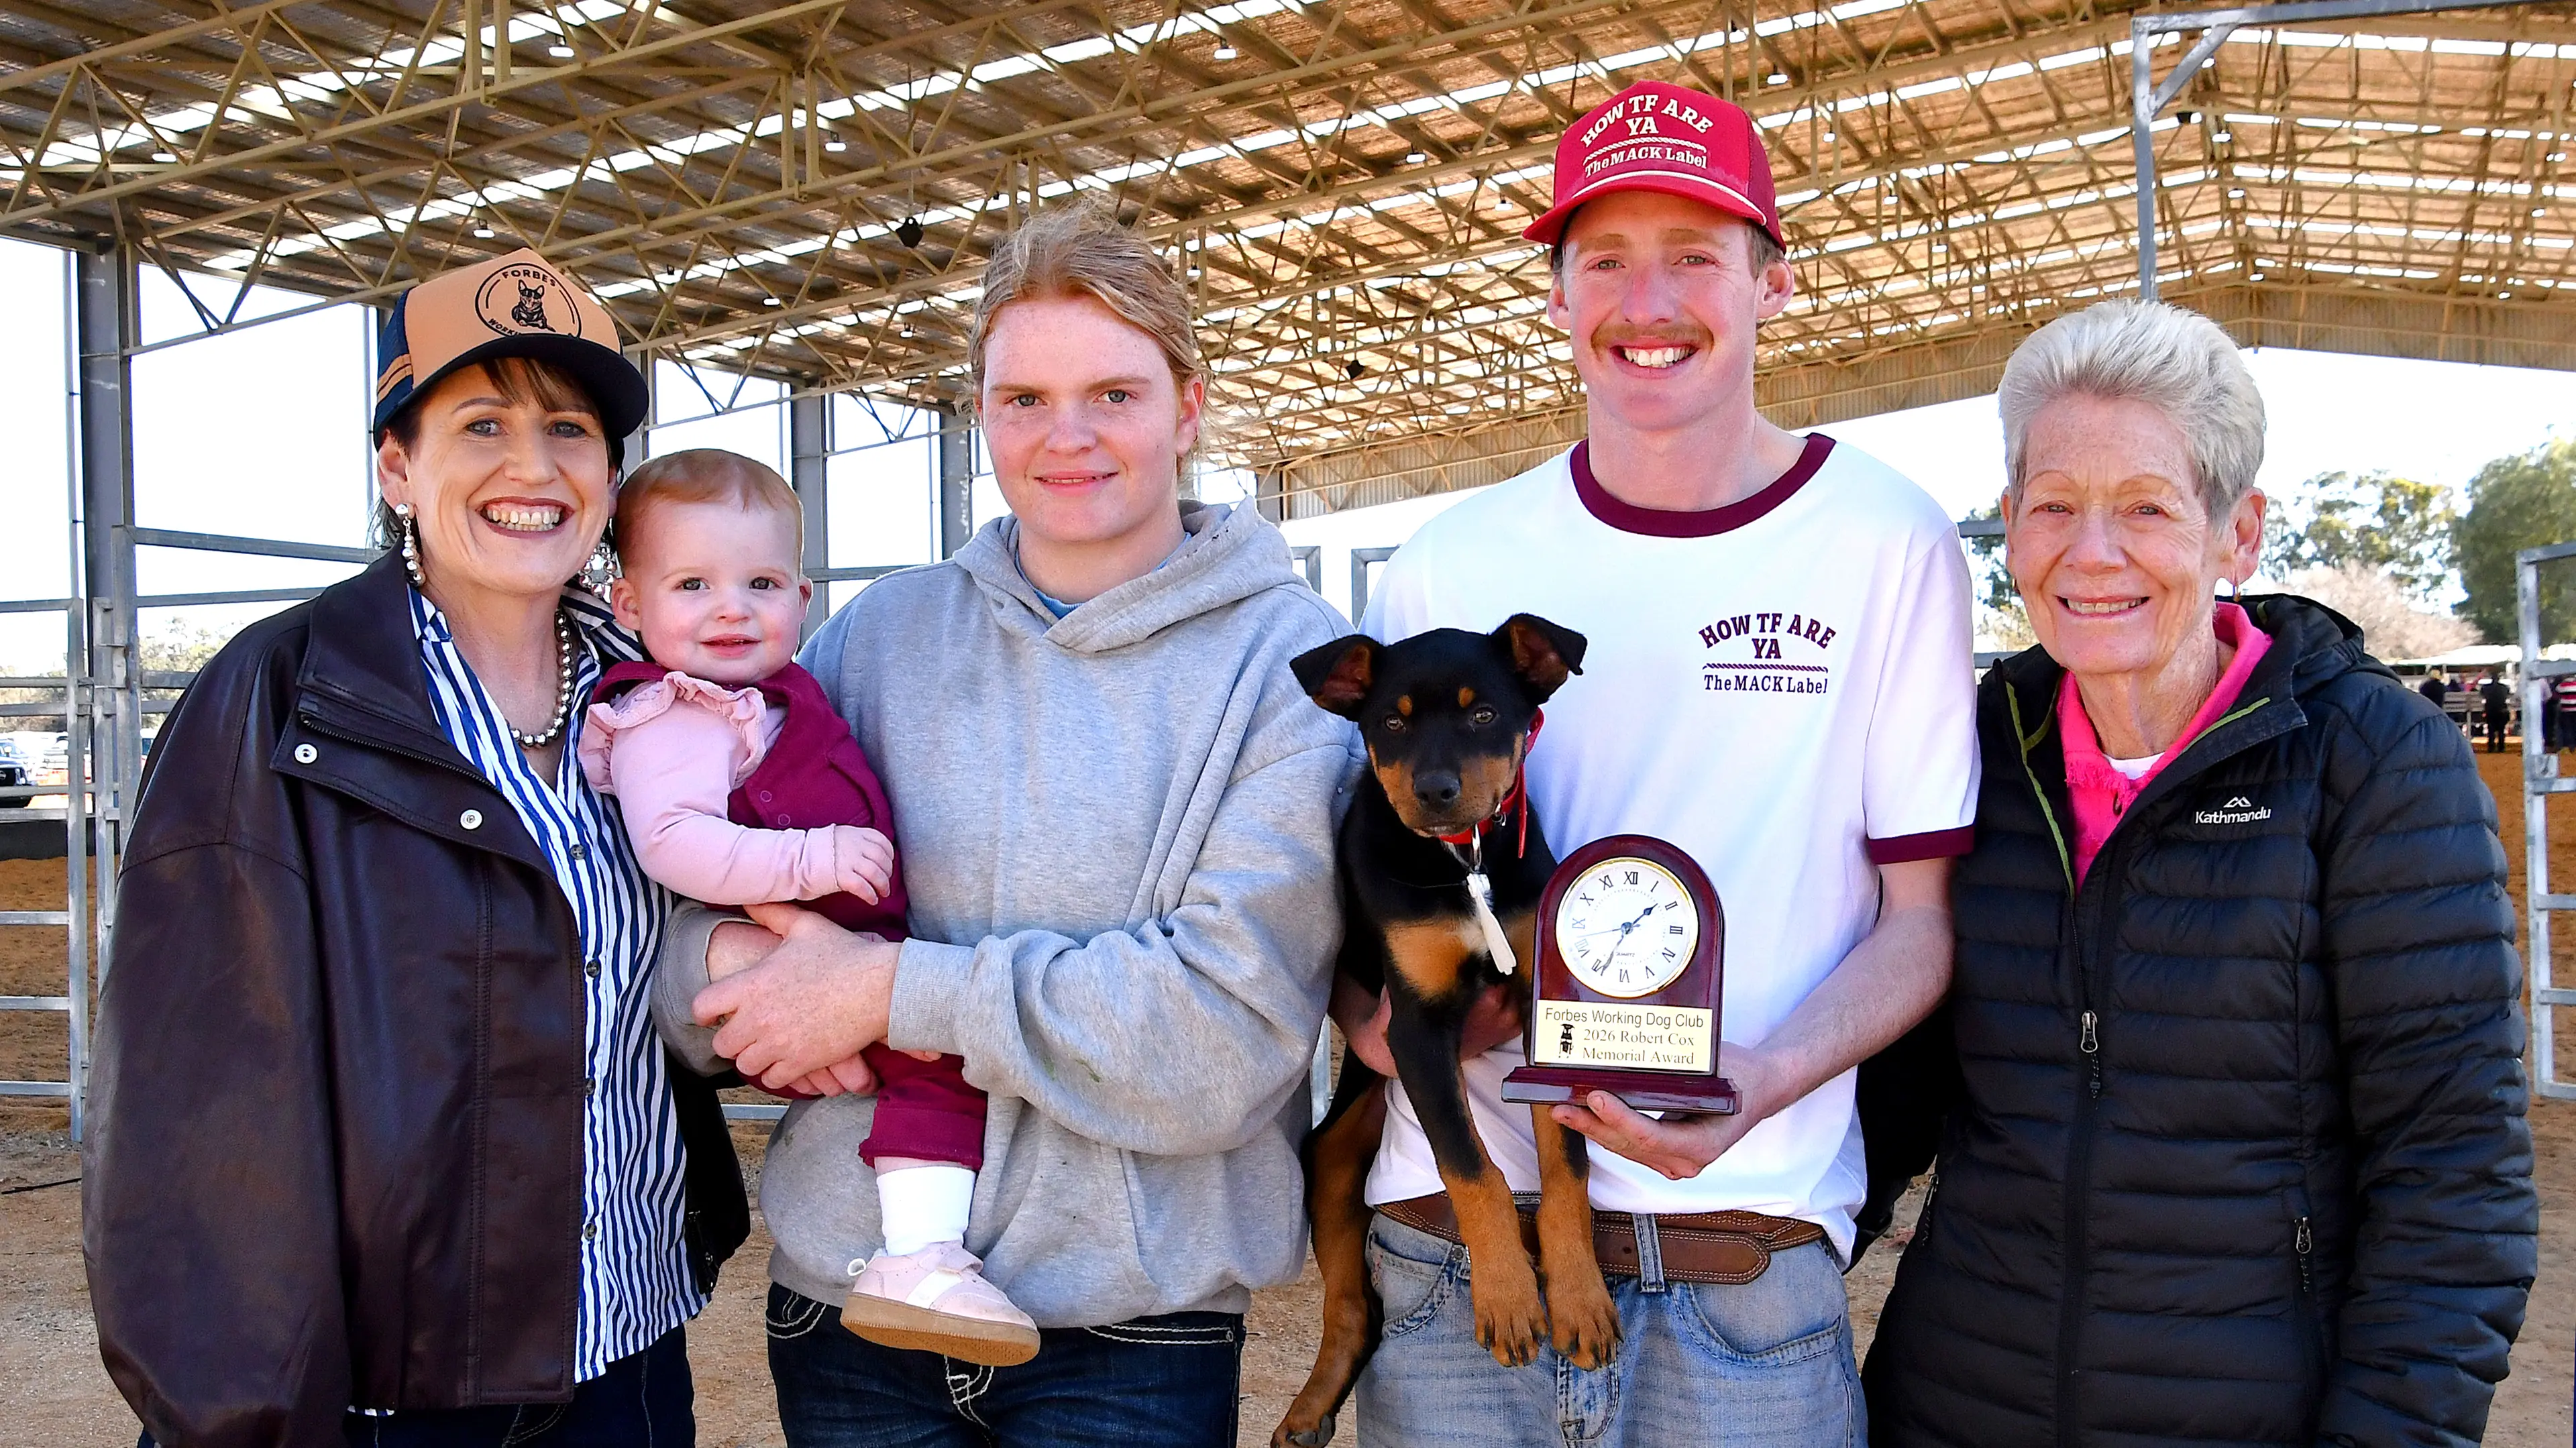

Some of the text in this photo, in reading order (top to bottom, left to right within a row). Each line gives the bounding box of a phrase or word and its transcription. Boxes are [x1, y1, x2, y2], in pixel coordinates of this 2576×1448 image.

[1580, 95, 1713, 148] HOW TF ARE
[1625, 116, 1659, 136] YA
[1665, 148, 1707, 169] Label
[502, 270, 556, 286] FORBES
[488, 319, 522, 335] WORKI
[1699, 613, 1836, 649] HOW TF ARE
[1752, 638, 1782, 659] YA
[1786, 677, 1828, 693] Label
[2195, 806, 2271, 824] Kathmandu
[1599, 875, 1613, 891] XI
[1623, 871, 1638, 885] XII
[1650, 881, 1659, 892] I
[1579, 893, 1595, 906] X
[1664, 901, 1678, 910] II
[1572, 918, 1585, 929] IX
[1669, 925, 1683, 935] III
[1662, 947, 1676, 963] IV
[1619, 969, 1629, 983] VI
[1645, 966, 1655, 979] V
[1546, 1007, 1703, 1029] Forbes Working Dog Club
[1584, 1029, 1694, 1046] 2026 Robert Cox
[1582, 1048, 1694, 1064] Memorial Award
